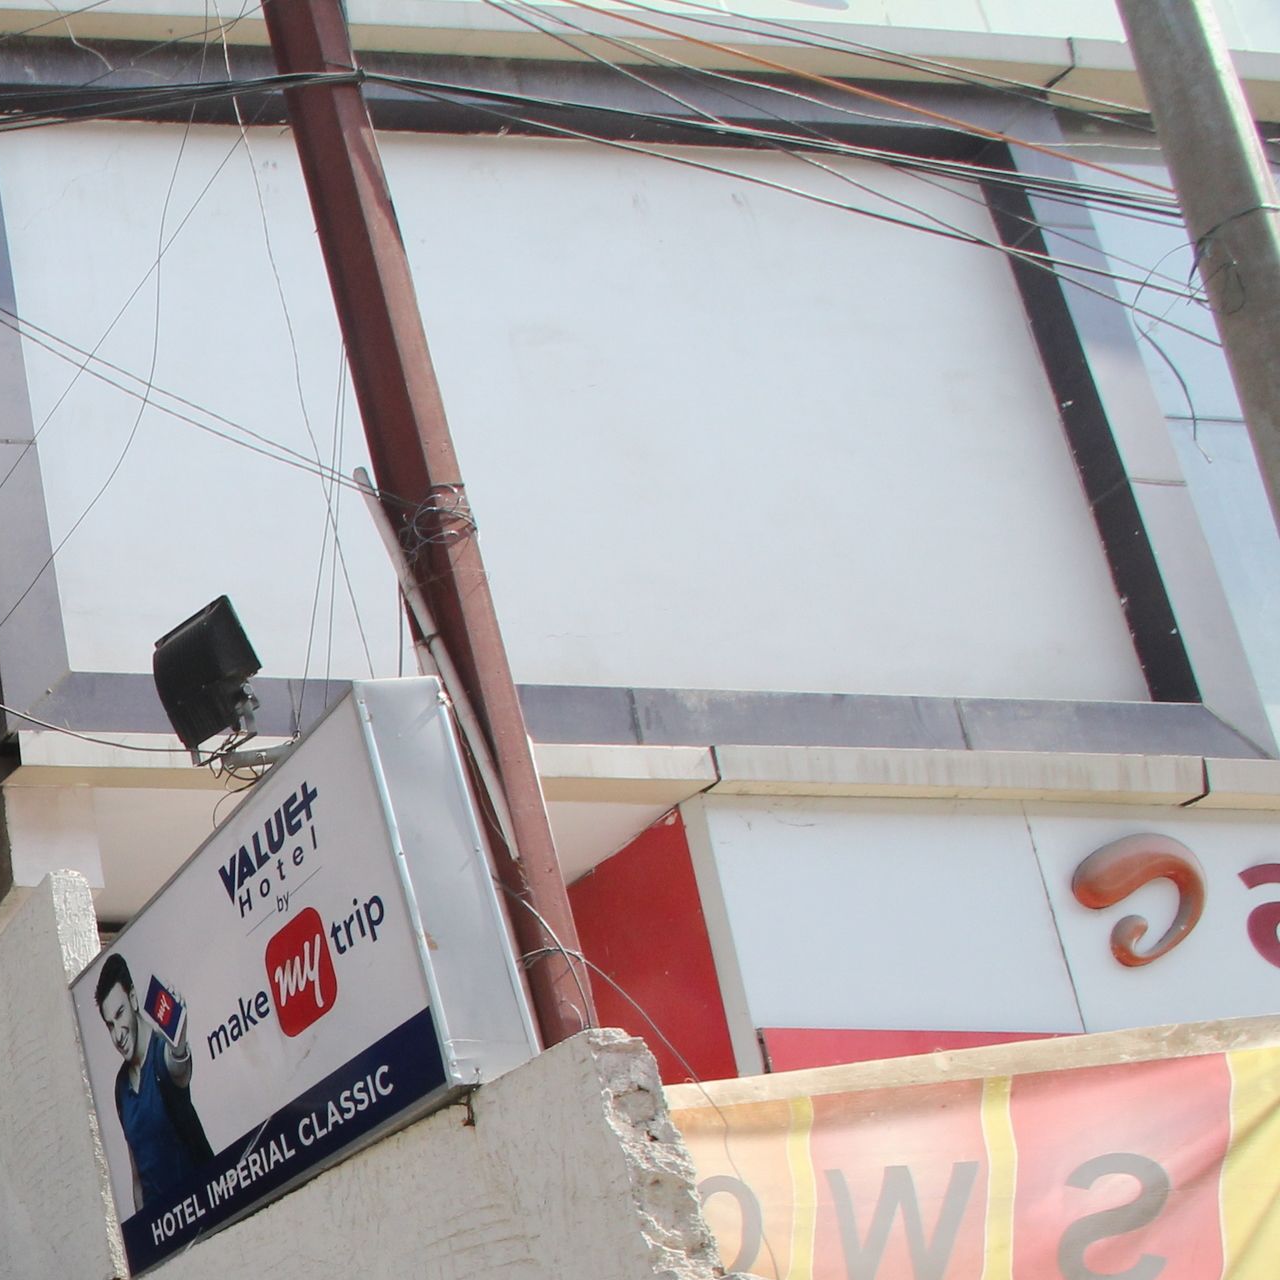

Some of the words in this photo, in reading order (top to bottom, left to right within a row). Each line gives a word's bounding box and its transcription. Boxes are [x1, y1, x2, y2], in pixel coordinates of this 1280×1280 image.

[237, 825, 318, 918] Hotel
[276, 891, 291, 914] by
[207, 989, 271, 1060] make
[274, 933, 324, 1009] my
[330, 894, 385, 955] trip
[151, 1194, 206, 1246] HOTEL
[207, 1139, 296, 1208] IMPERIAL
[297, 1063, 394, 1148] CLASSIC
